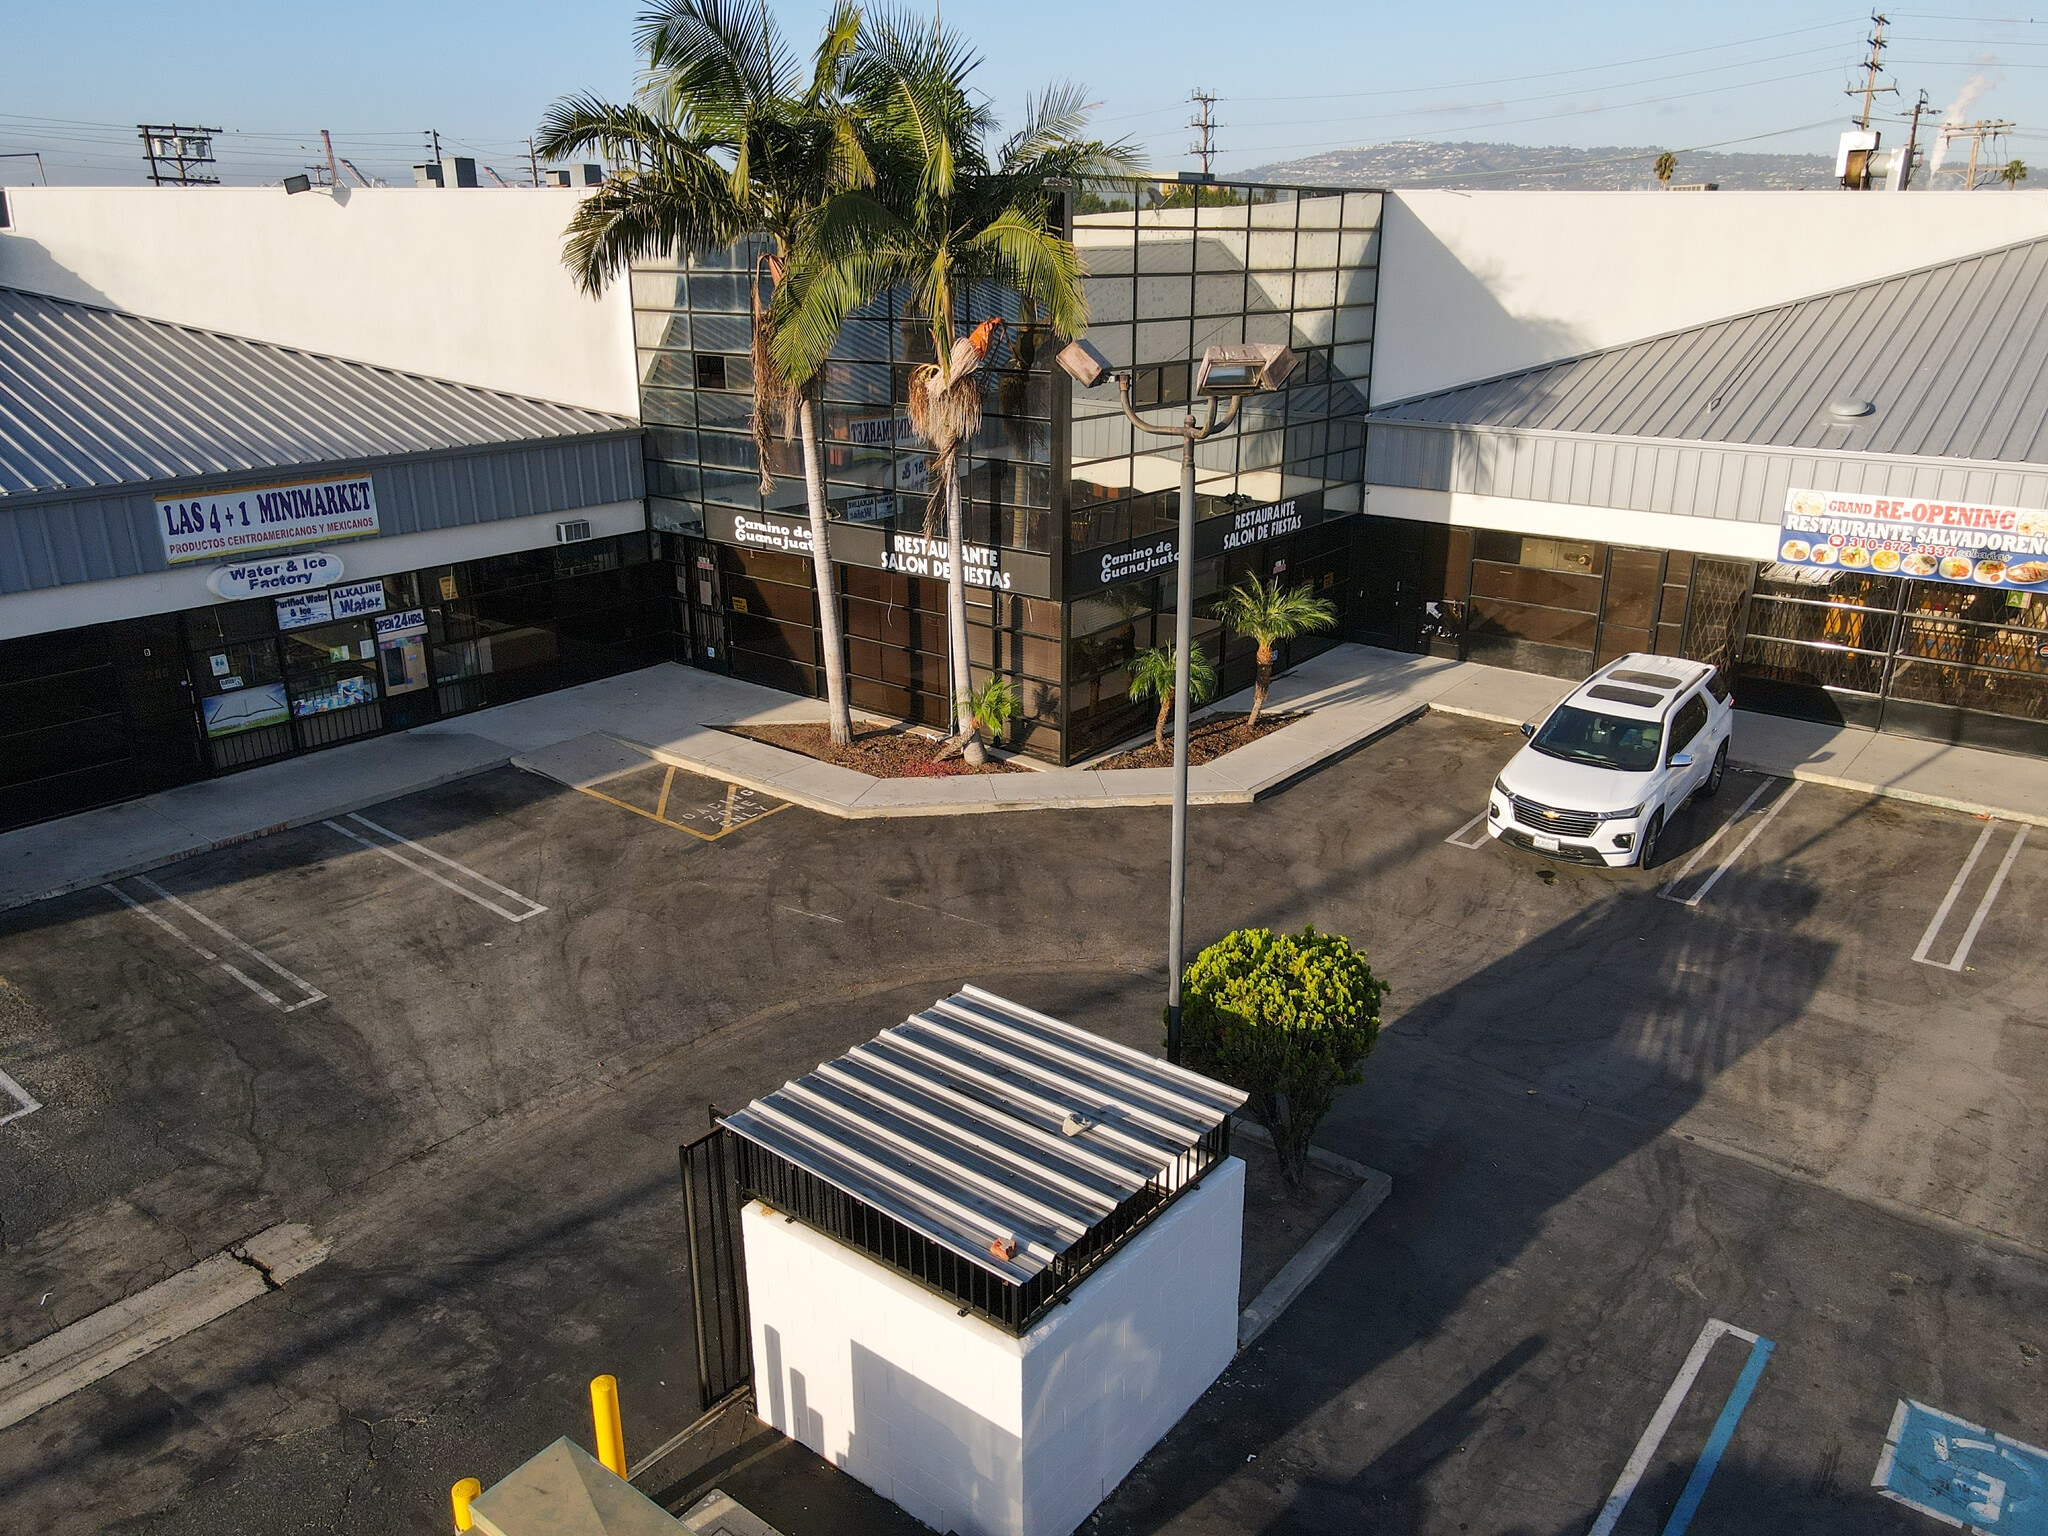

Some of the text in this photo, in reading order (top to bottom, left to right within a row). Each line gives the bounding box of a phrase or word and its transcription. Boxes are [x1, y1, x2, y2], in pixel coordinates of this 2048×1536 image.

[164, 482, 370, 535] LAS 4 + 1 MINIMARKET
[1235, 501, 1295, 530] RESTAURANTE
[1829, 500, 2016, 530] GRAND RE-OPENING
[169, 517, 374, 554] PRODUCTOS CENTROAMERICANOS Y MEXICANOS
[734, 515, 812, 540] Camino de
[1224, 515, 1302, 550] SALON DE FIESTAS
[1786, 515, 1912, 542] RESTAURANTE
[735, 529, 815, 552] Guanajuat
[894, 535, 998, 568] RESTAUANTE
[1849, 537, 1956, 558] 310-872-3337
[1101, 541, 1172, 569] Camino de
[230, 557, 327, 581] Water & Ice
[881, 551, 1011, 589] SALON DE IESTAS
[249, 572, 313, 591] Factory
[333, 583, 382, 600] ALKALINE
[275, 593, 328, 609] Purified Water
[340, 597, 381, 614] Water
[2009, 594, 2019, 604] A
[290, 606, 311, 617] & Ice
[376, 618, 395, 632] OPEN
[394, 613, 408, 628] 24
[332, 651, 341, 661] A
[704, 800, 757, 822] ZONE
[719, 805, 768, 827] ONLY
